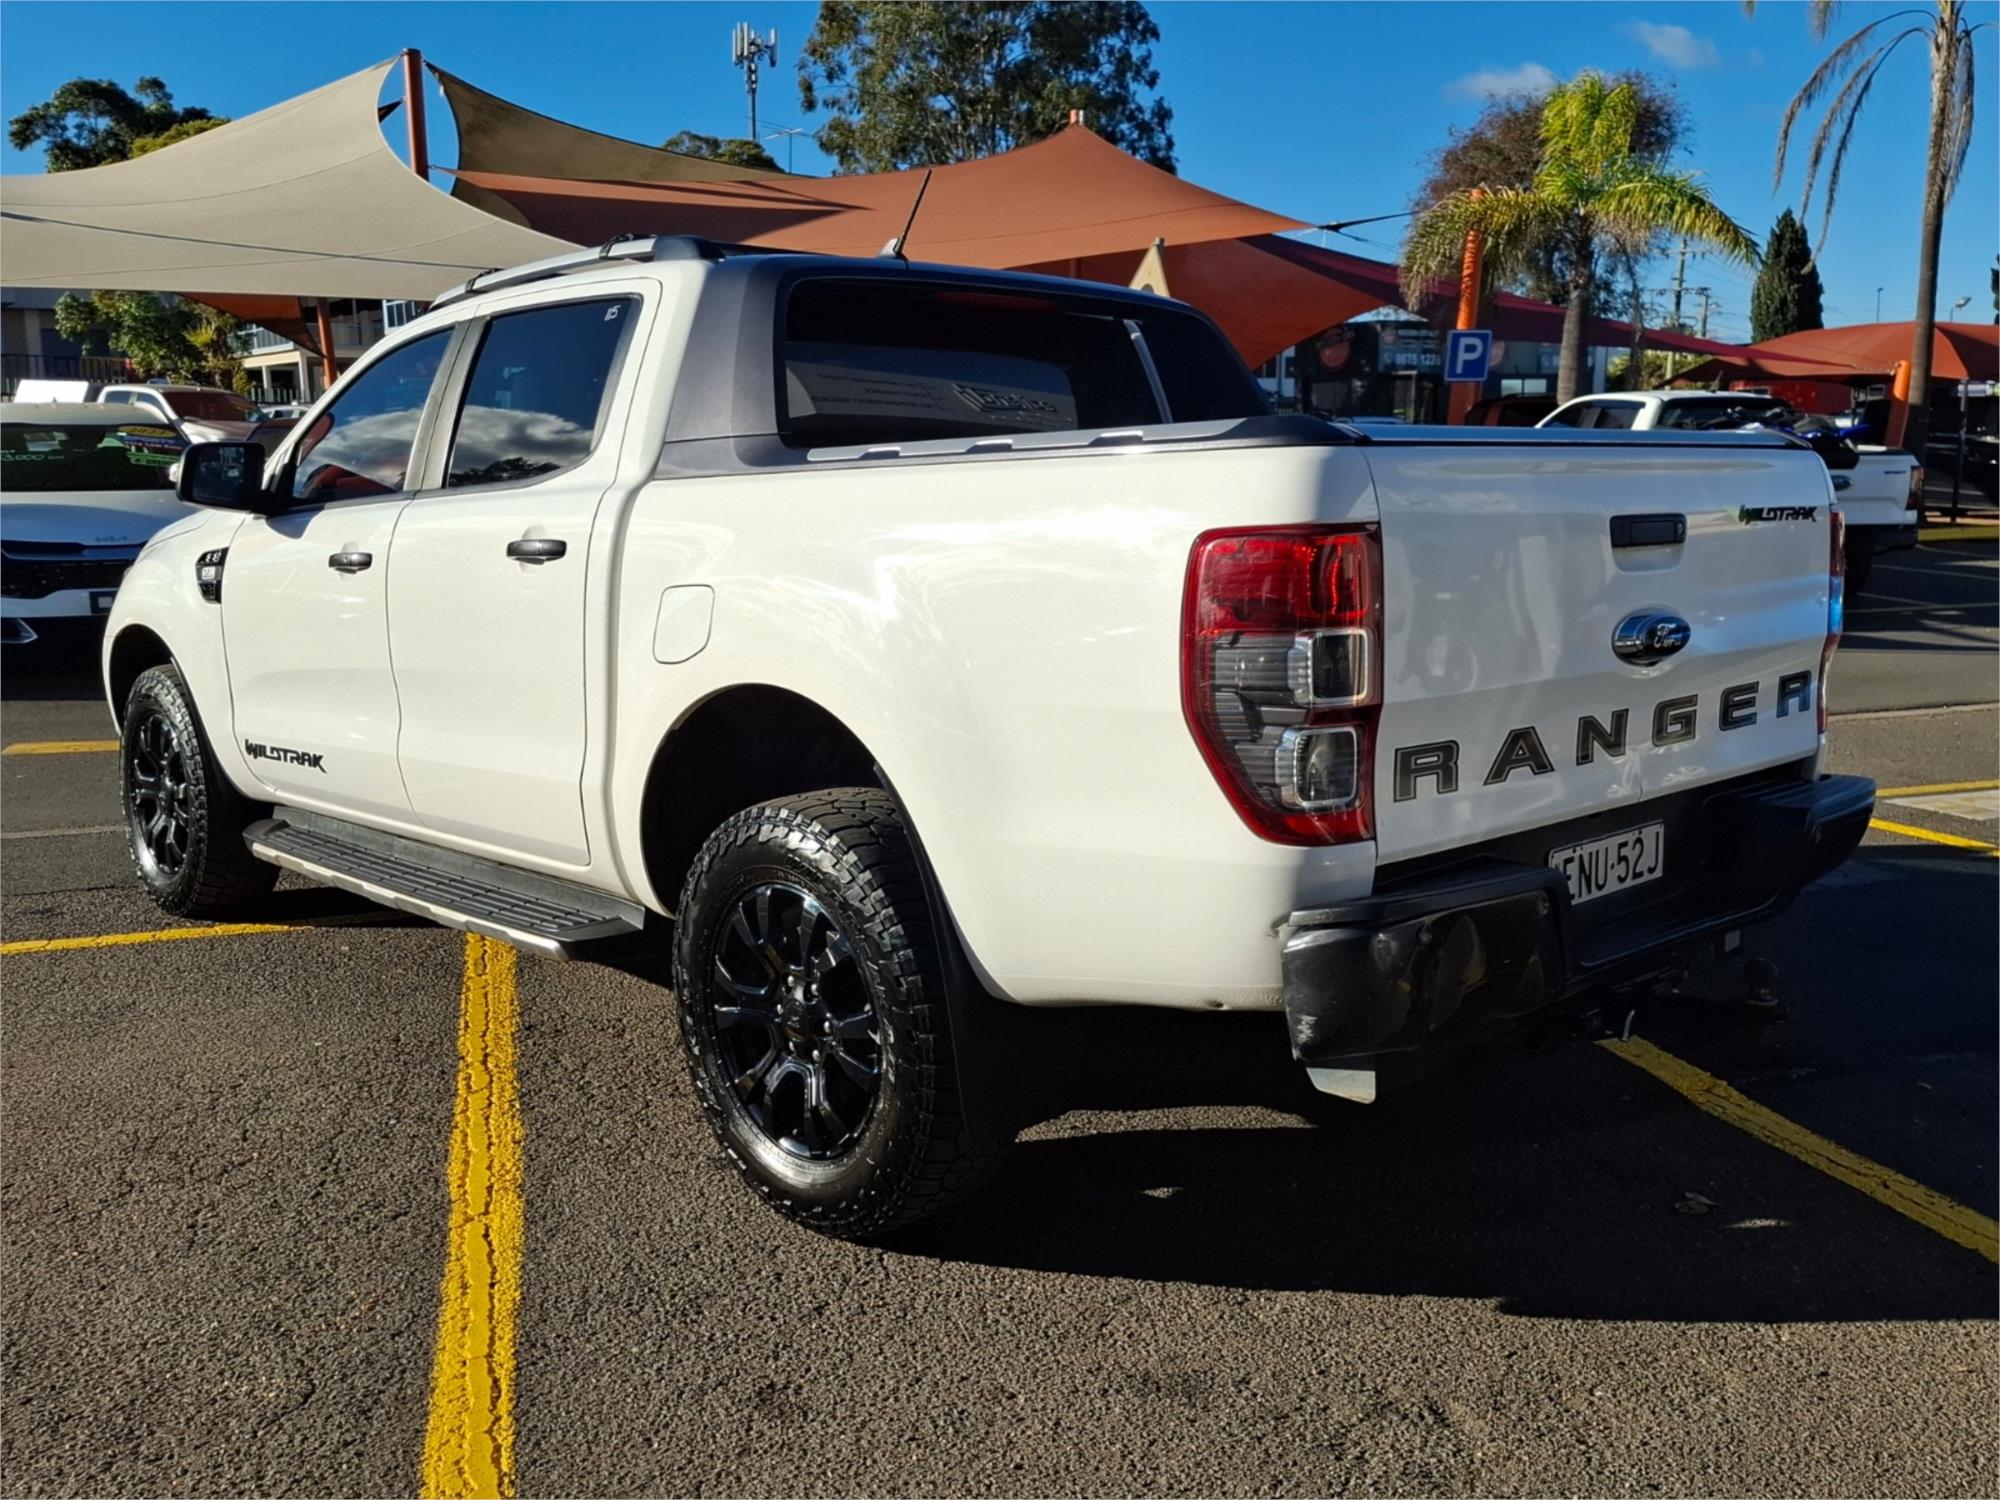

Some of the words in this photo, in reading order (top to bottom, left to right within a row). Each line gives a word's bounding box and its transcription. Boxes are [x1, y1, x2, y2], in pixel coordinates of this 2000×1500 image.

[1456, 337, 1484, 374] P
[1738, 504, 1818, 526] WILDTRAK
[1393, 670, 1812, 803] RANGER
[244, 738, 328, 774] WILDTRAK
